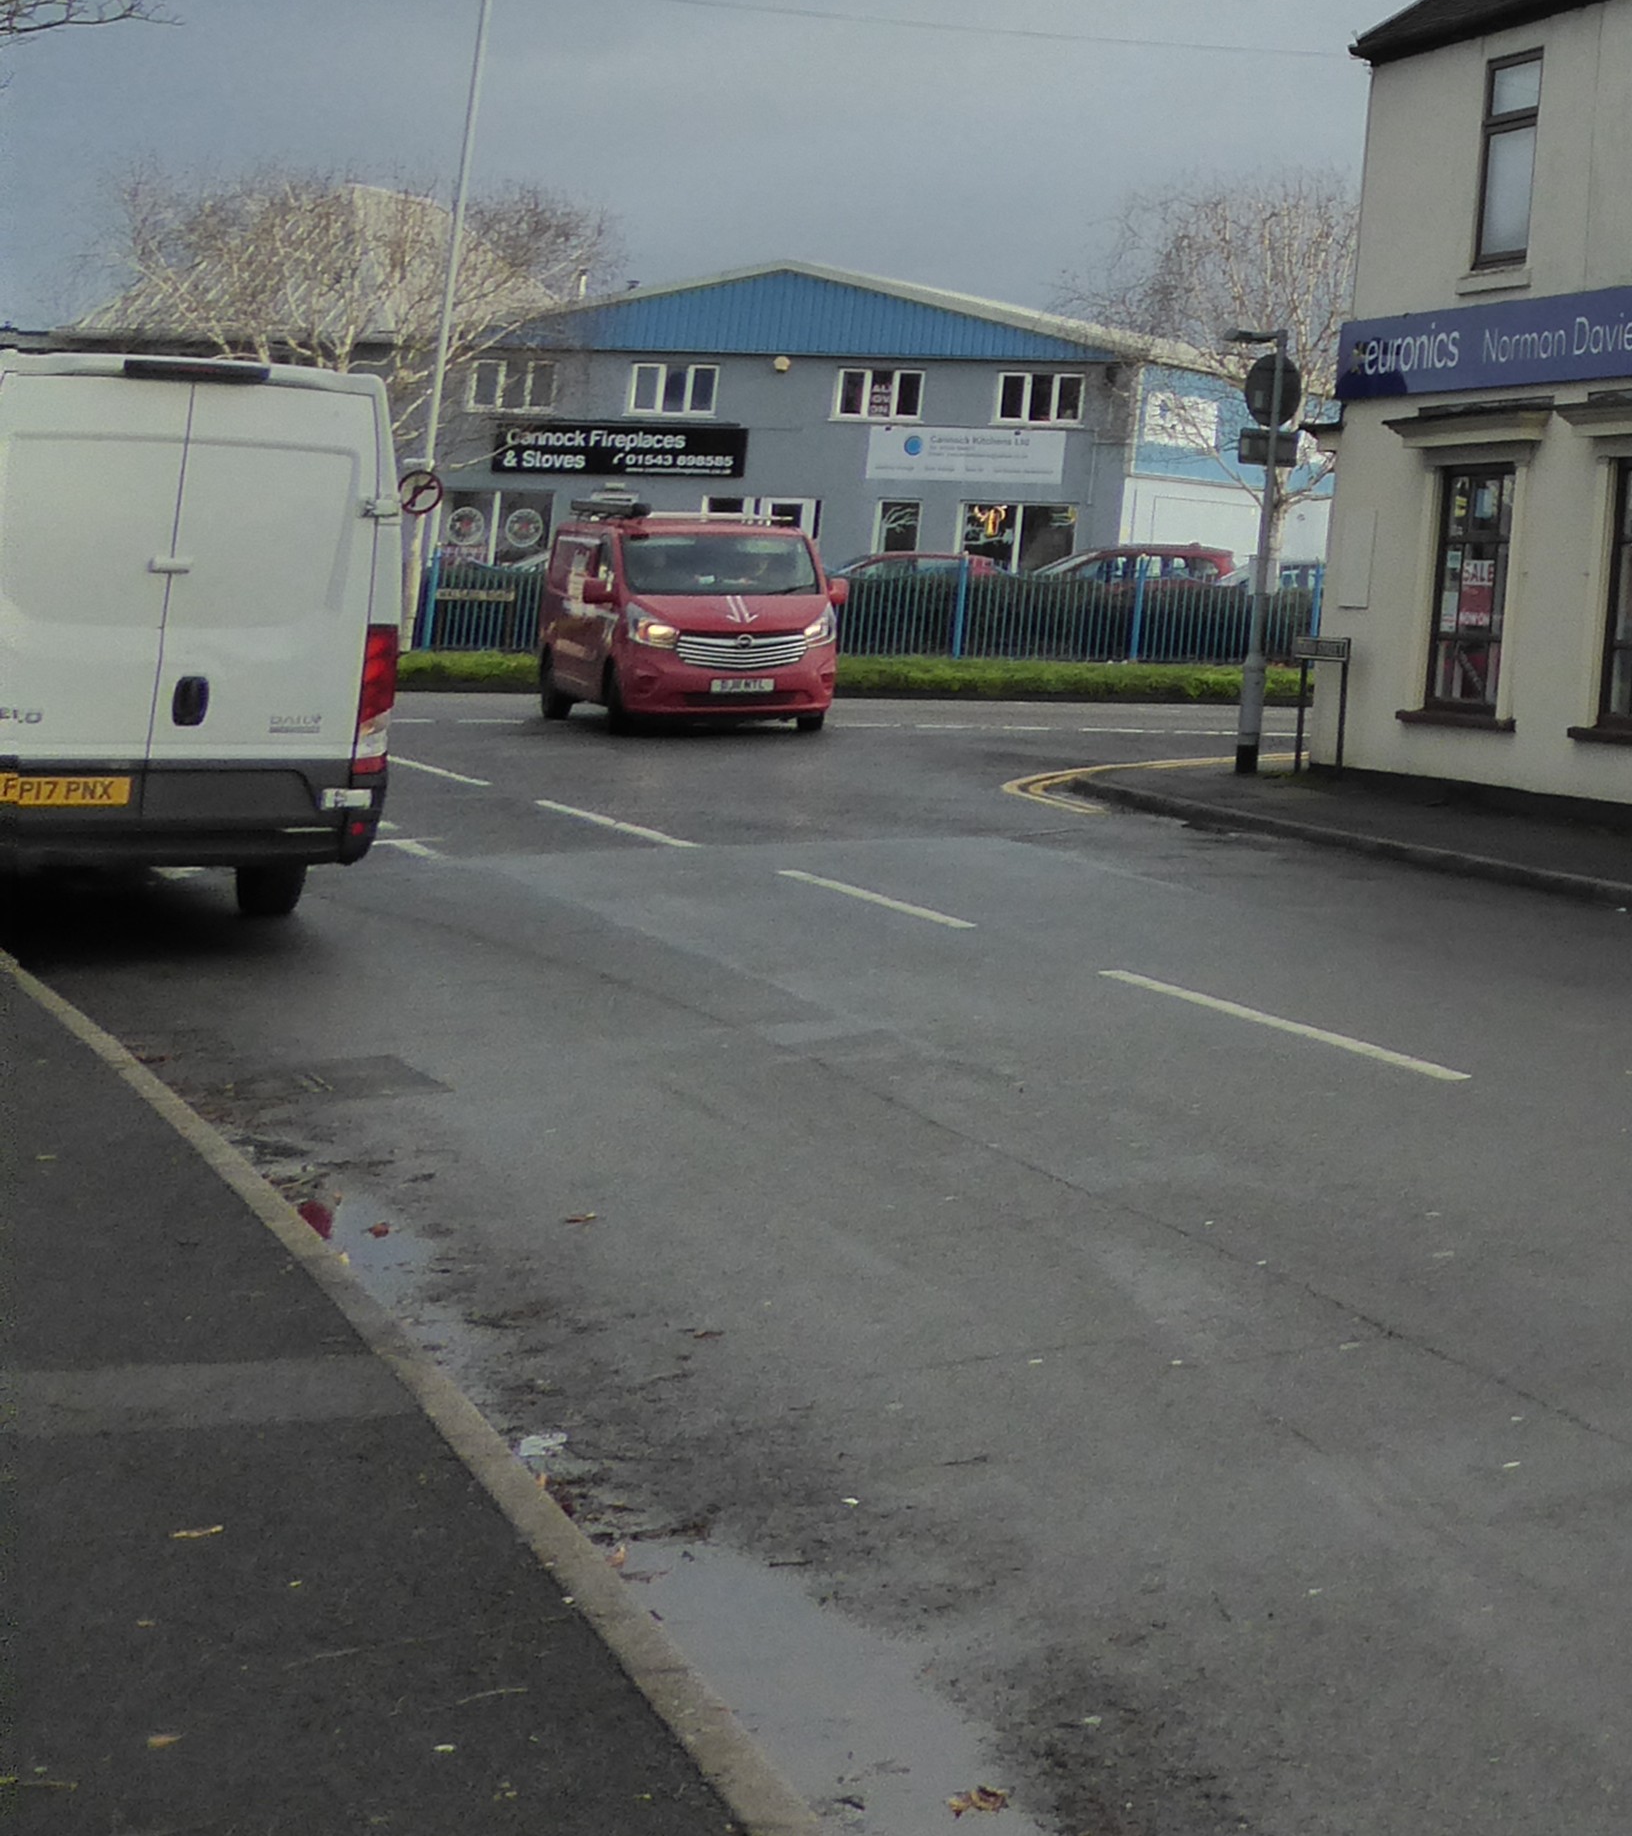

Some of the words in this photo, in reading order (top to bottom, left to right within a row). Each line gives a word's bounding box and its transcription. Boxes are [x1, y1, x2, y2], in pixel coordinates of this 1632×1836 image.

[1364, 322, 1460, 375] euronics
[1482, 328, 1566, 363] Norman
[506, 428, 586, 447] Cannock
[590, 430, 687, 450] Fireplaces
[503, 451, 517, 468] &
[522, 450, 586, 469] Stoves
[625, 453, 672, 465] 01543
[1463, 562, 1494, 584] SALE
[3, 777, 59, 800] FP17
[65, 780, 114, 800] PNX
